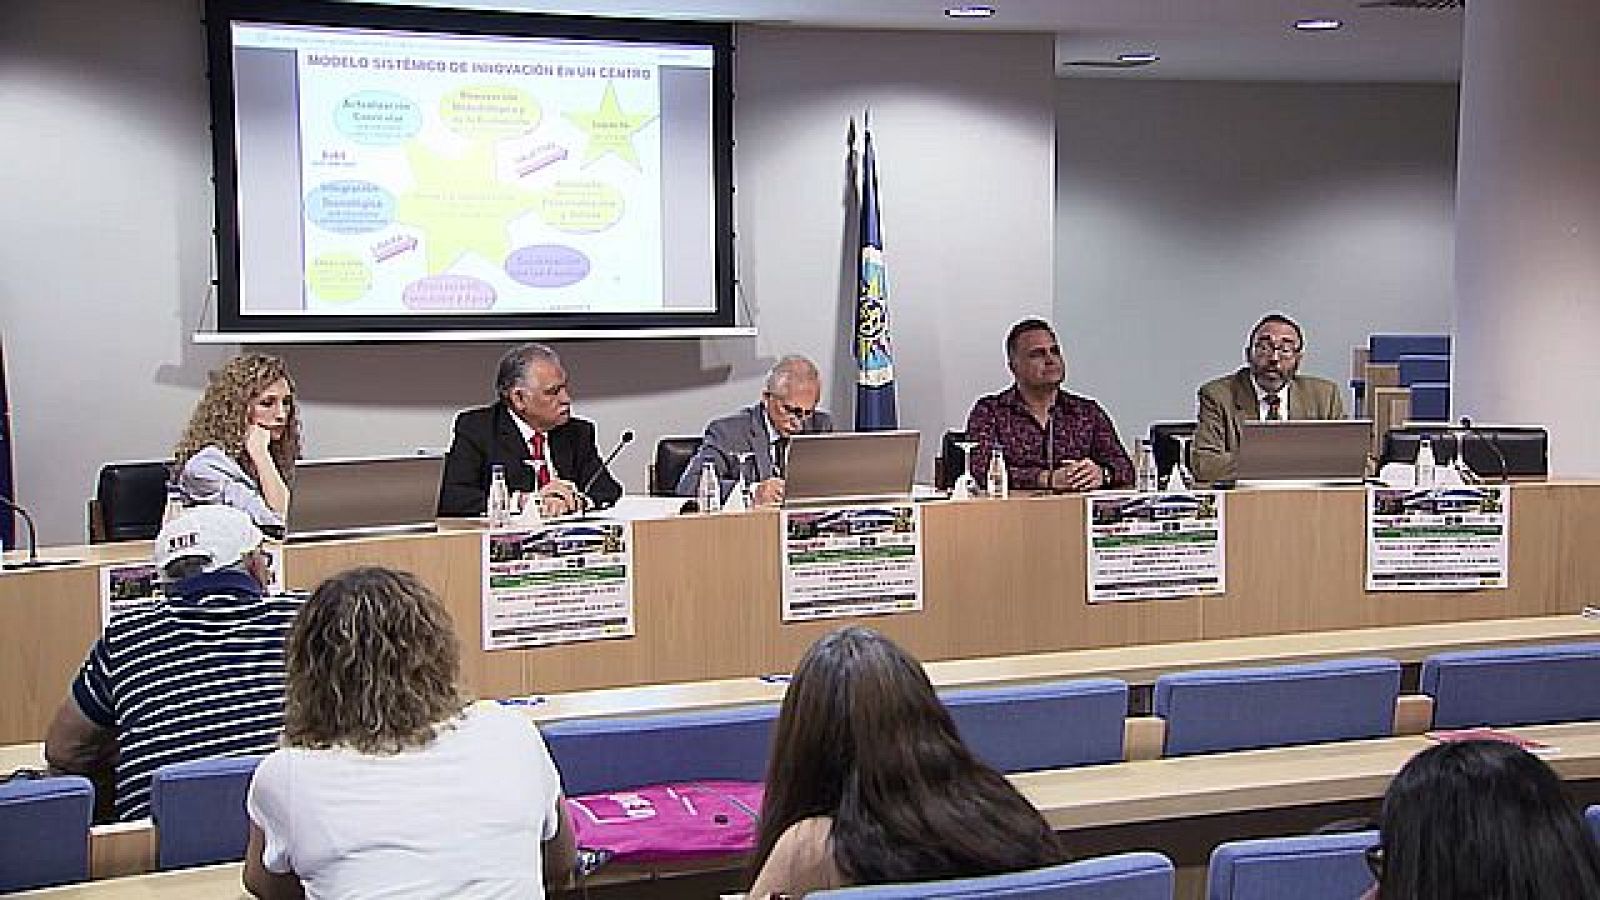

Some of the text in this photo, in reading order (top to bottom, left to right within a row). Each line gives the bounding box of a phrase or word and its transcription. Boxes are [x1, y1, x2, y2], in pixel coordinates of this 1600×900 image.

[307, 55, 651, 80] MODELO SISTÉMICO DE INNOVACIÓN EN UN CENTRO
